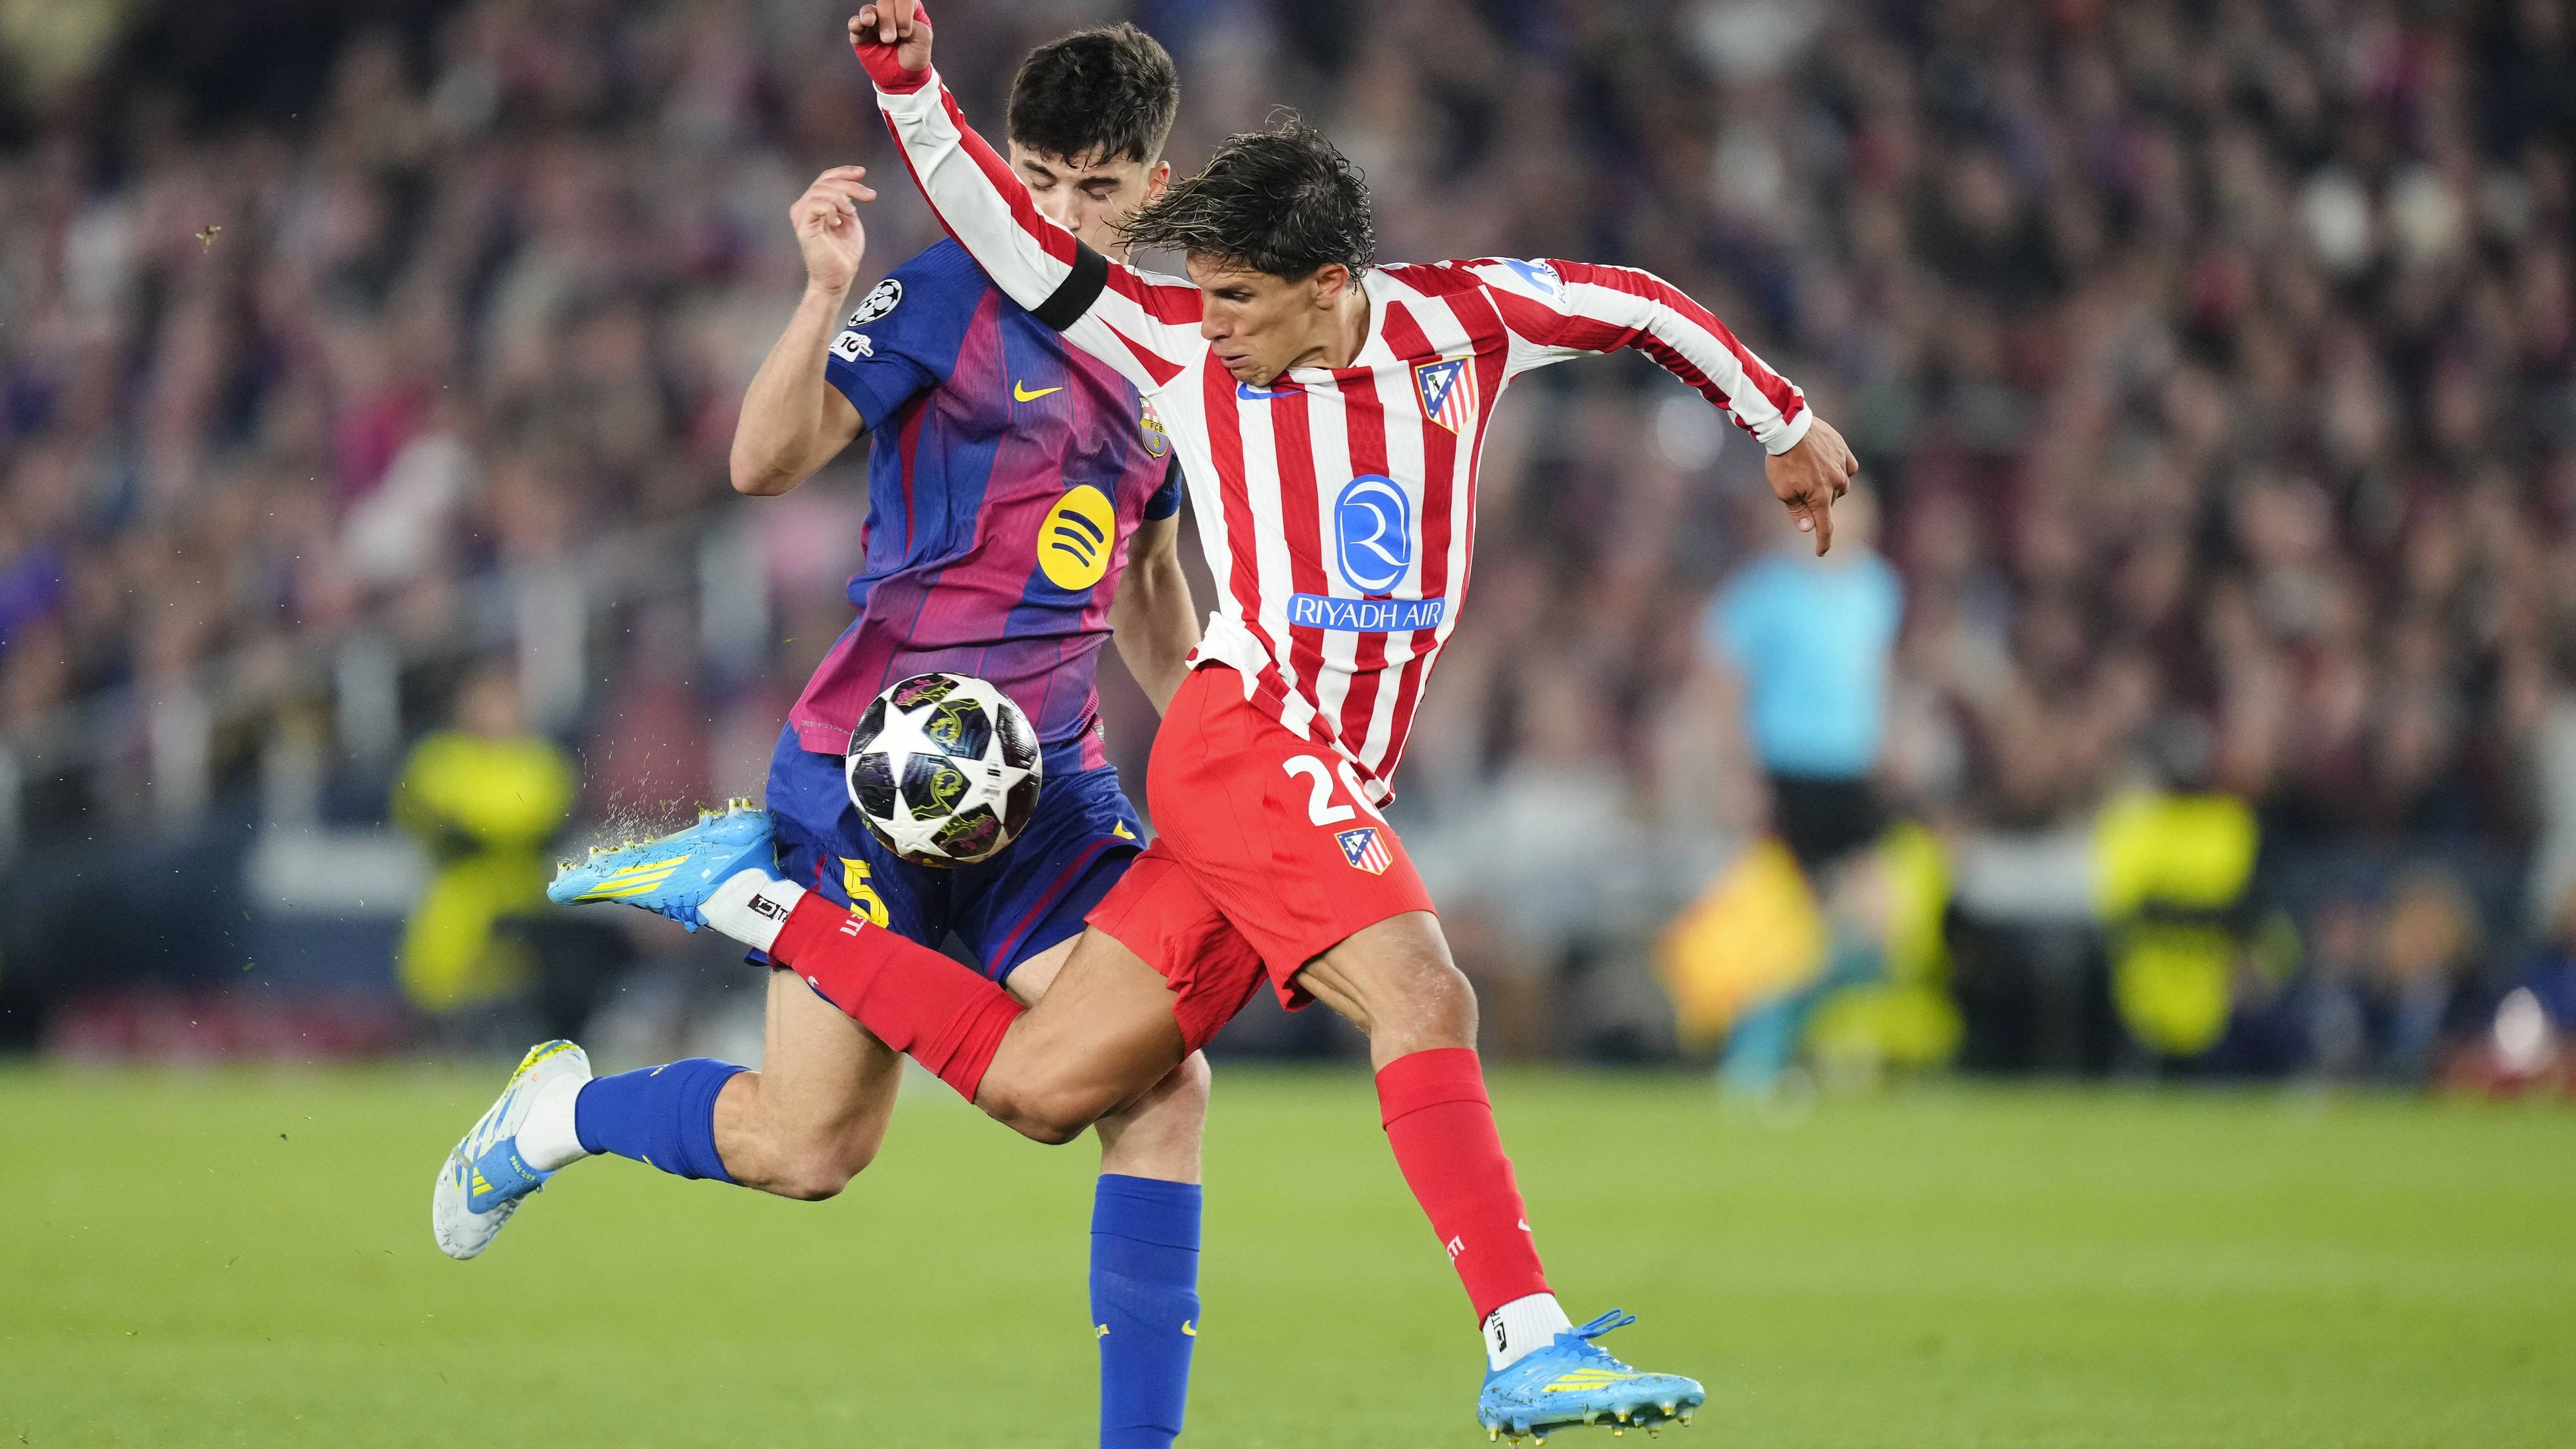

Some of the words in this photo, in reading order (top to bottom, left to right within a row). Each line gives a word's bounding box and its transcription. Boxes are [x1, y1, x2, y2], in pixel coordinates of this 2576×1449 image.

[1150, 422, 1163, 433] FCB
[1294, 597, 1397, 629] RIYADH
[1402, 601, 1442, 628] AIR
[838, 857, 889, 929] 5
